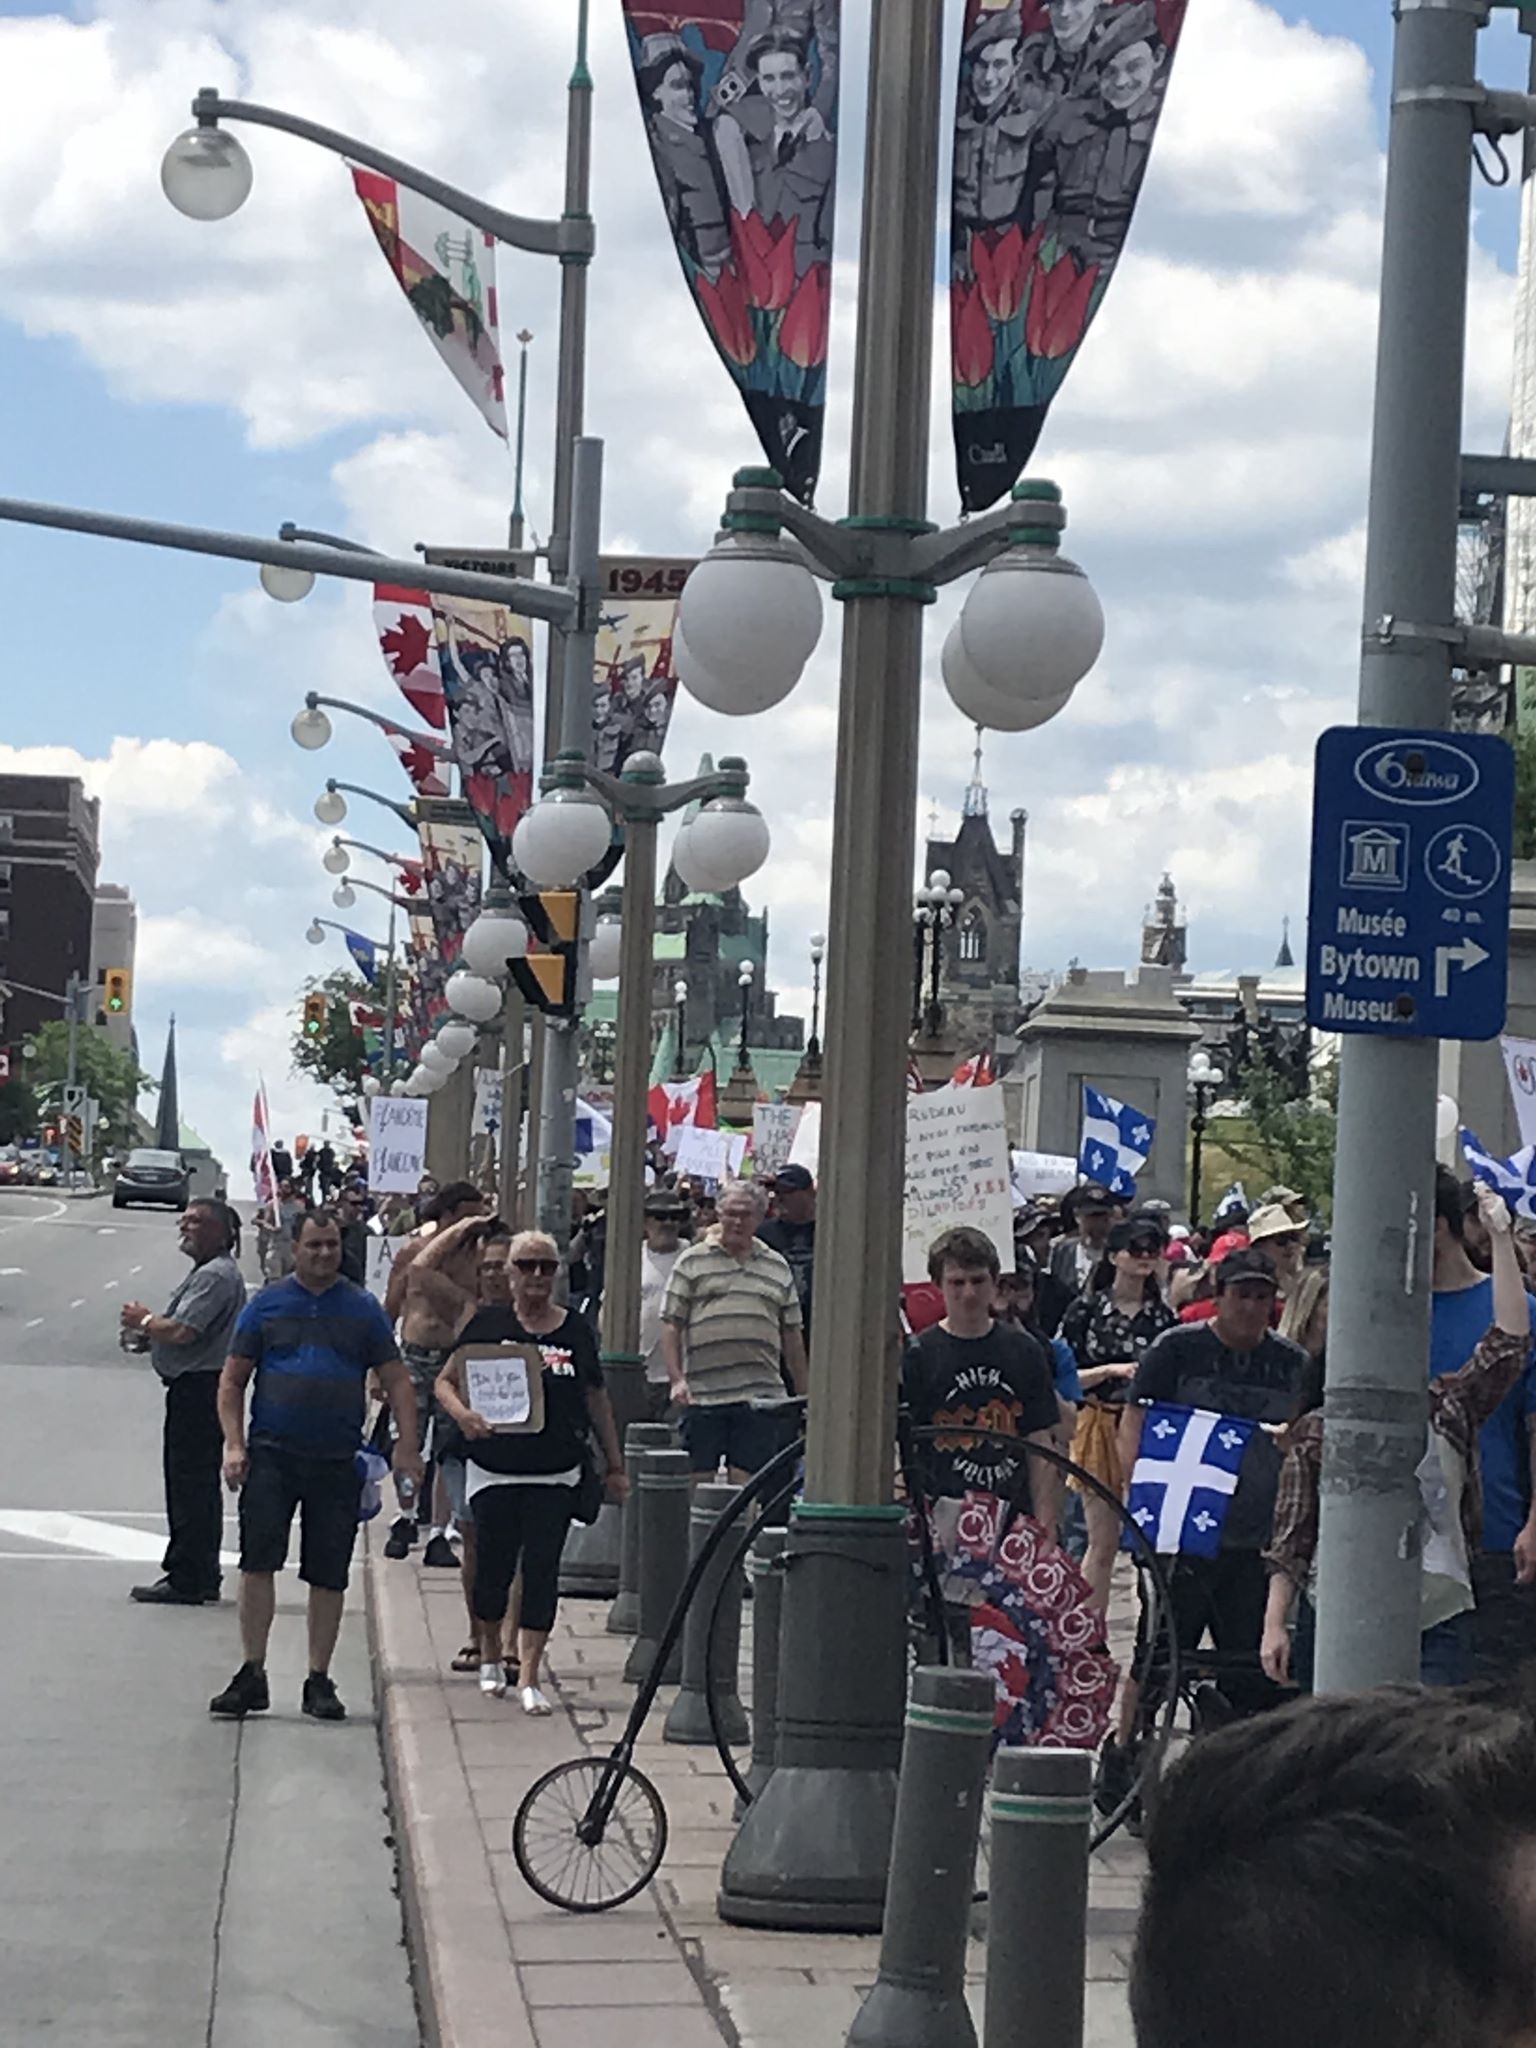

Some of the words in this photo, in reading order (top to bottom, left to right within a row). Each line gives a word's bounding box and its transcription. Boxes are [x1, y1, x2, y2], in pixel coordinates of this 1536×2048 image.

[608, 568, 686, 594] 1945
[1337, 906, 1408, 937] Musée
[1320, 944, 1420, 985] Bytown
[757, 1107, 792, 1127] THE
[955, 1366, 1002, 1390] HIGH
